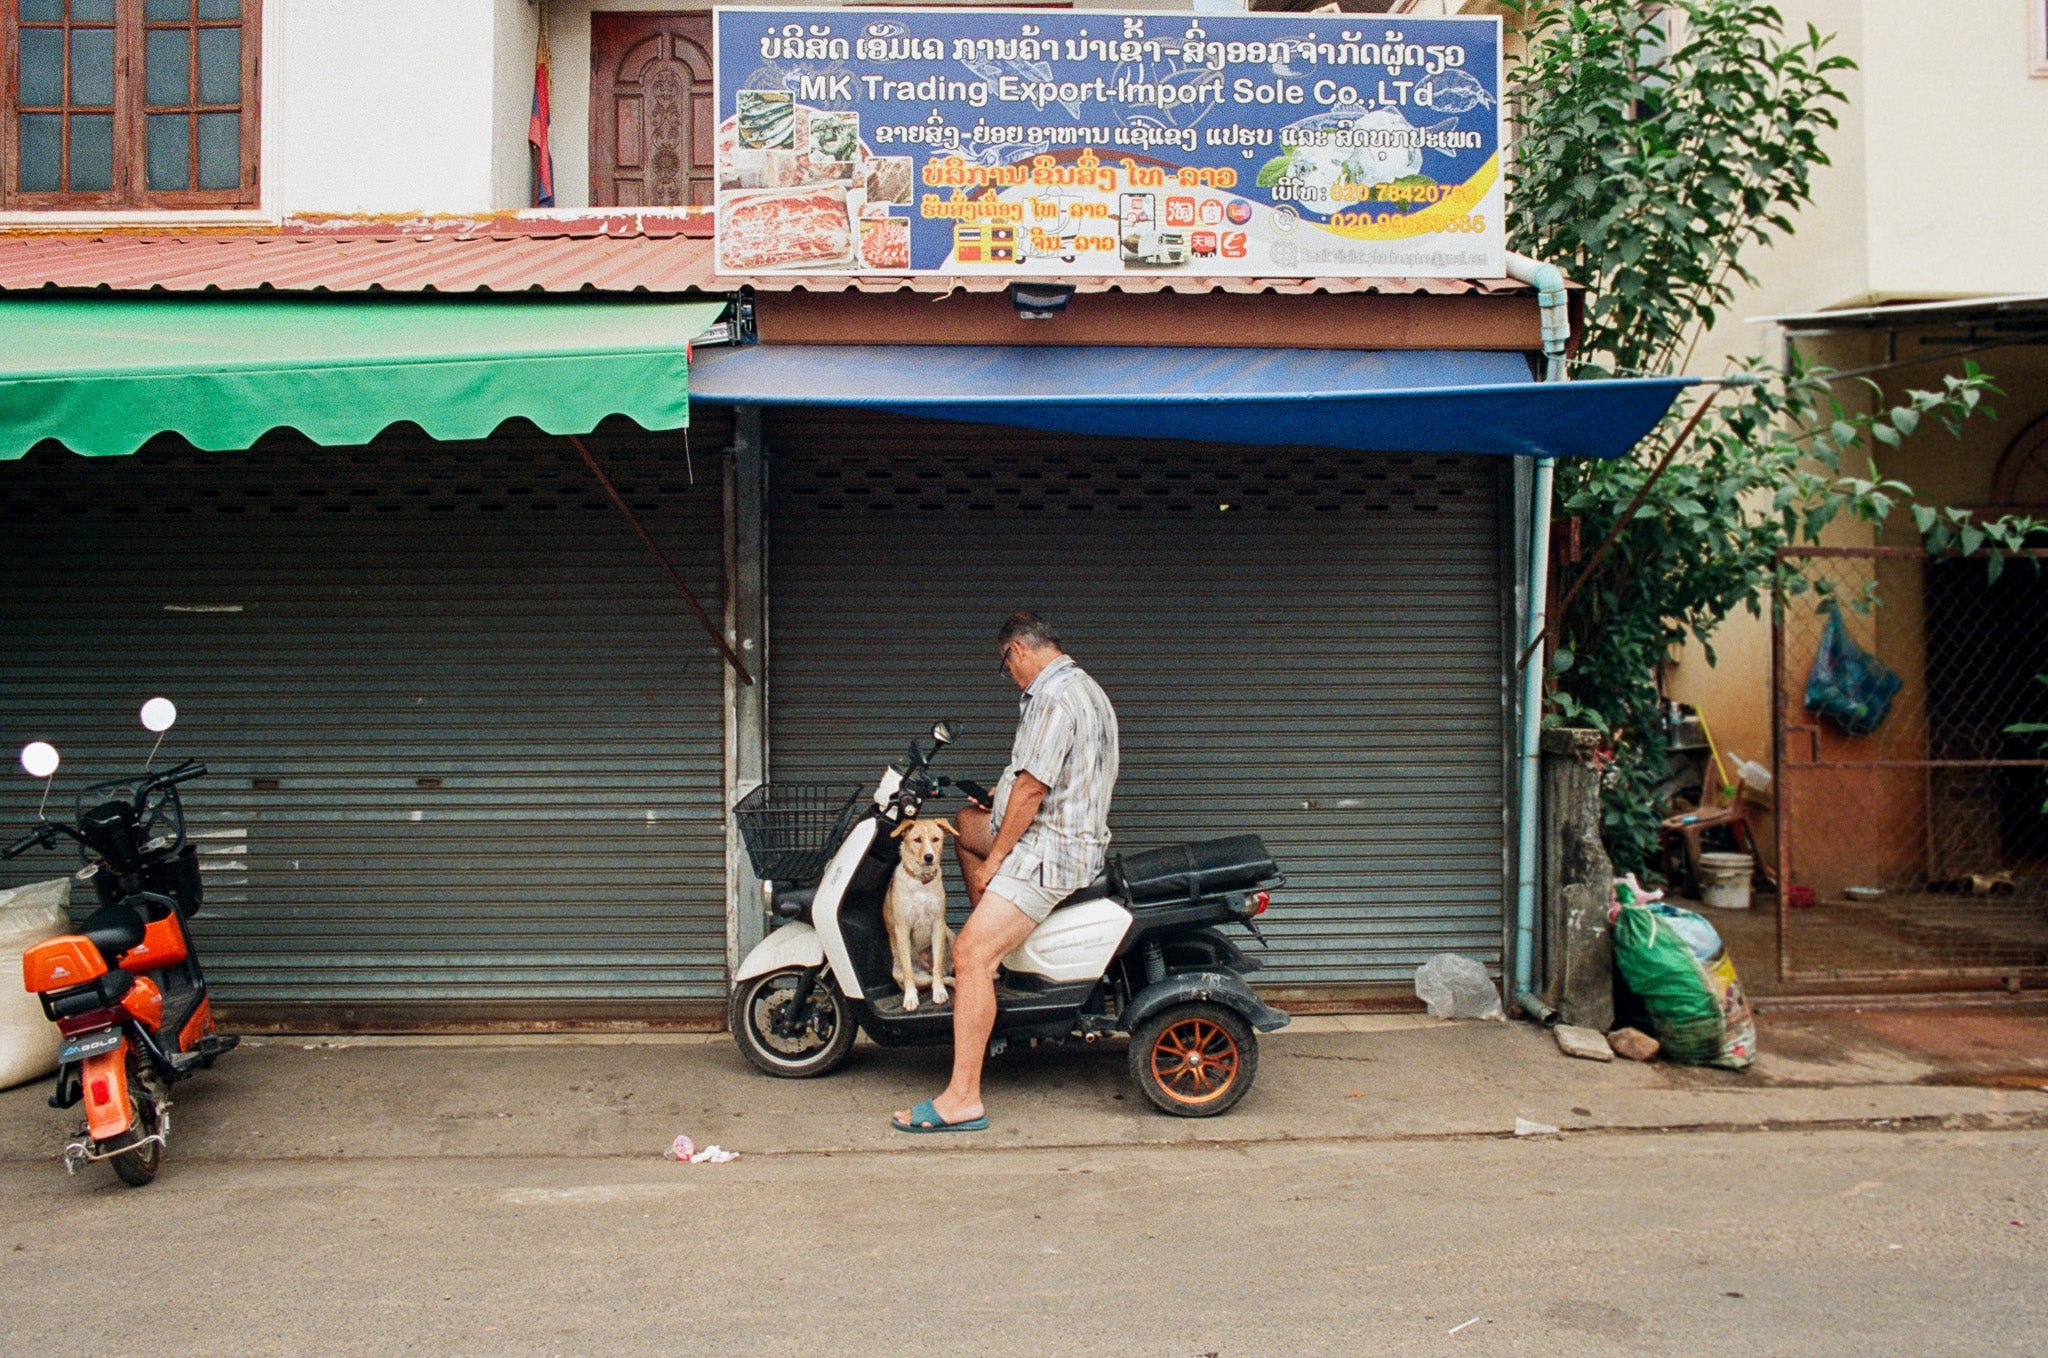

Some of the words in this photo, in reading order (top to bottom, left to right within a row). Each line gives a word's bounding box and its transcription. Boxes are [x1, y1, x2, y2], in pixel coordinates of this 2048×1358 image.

[760, 23, 850, 61] ບໍລິສັດ
[856, 24, 944, 61] ເອັມເຄ
[953, 23, 1059, 62] ການຄ້າ
[799, 75, 853, 102] MK
[860, 75, 988, 107] Trading
[998, 75, 1226, 109] Export-Import
[1233, 78, 1304, 105] Sole
[1313, 79, 1434, 110] Co.,LTd
[1280, 127, 1329, 148] ແລະ
[1330, 182, 1371, 203] 020
[1167, 201, 1194, 222] 淘
[1330, 212, 1373, 233] 020
[1192, 235, 1216, 248] 天猫
